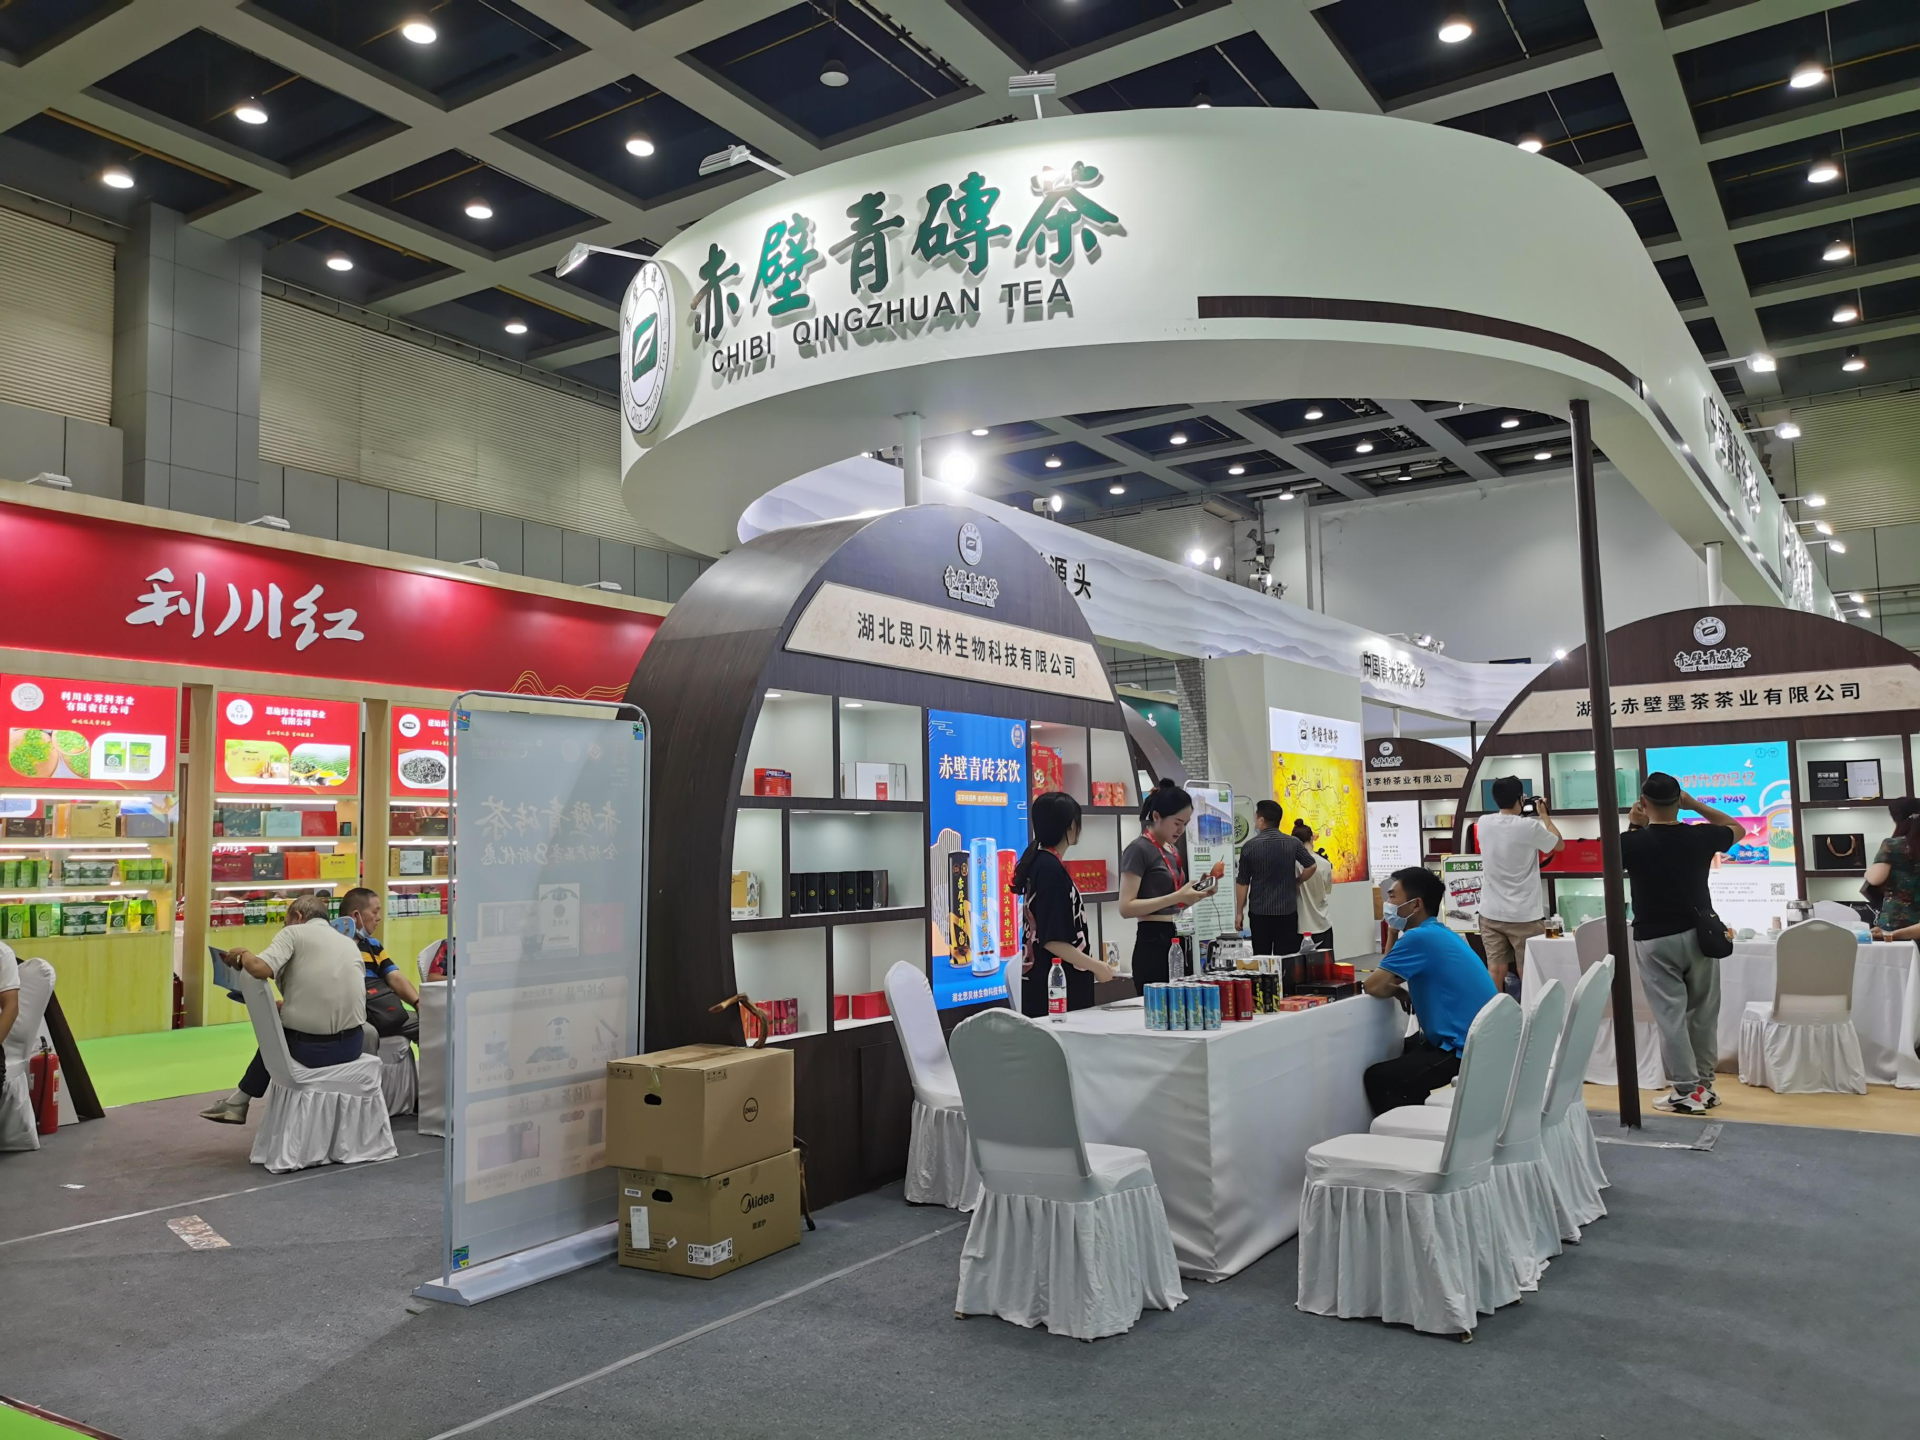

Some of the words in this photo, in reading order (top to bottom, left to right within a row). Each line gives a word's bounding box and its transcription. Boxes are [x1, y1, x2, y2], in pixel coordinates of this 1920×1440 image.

[711, 331, 772, 373] CHIBI
[792, 287, 980, 346] QINGZHUAN
[1001, 278, 1071, 310] TEA
[125, 567, 365, 651] 利川红
[857, 611, 1076, 679] 湖北思贝林生物科技有限公司
[66, 702, 130, 716] 有限责任公司
[281, 717, 312, 727] 有限公司
[938, 753, 1021, 783] 赤壁青砖茶饮
[745, 1106, 757, 1115] DELL
[740, 1193, 775, 1214] Midea
